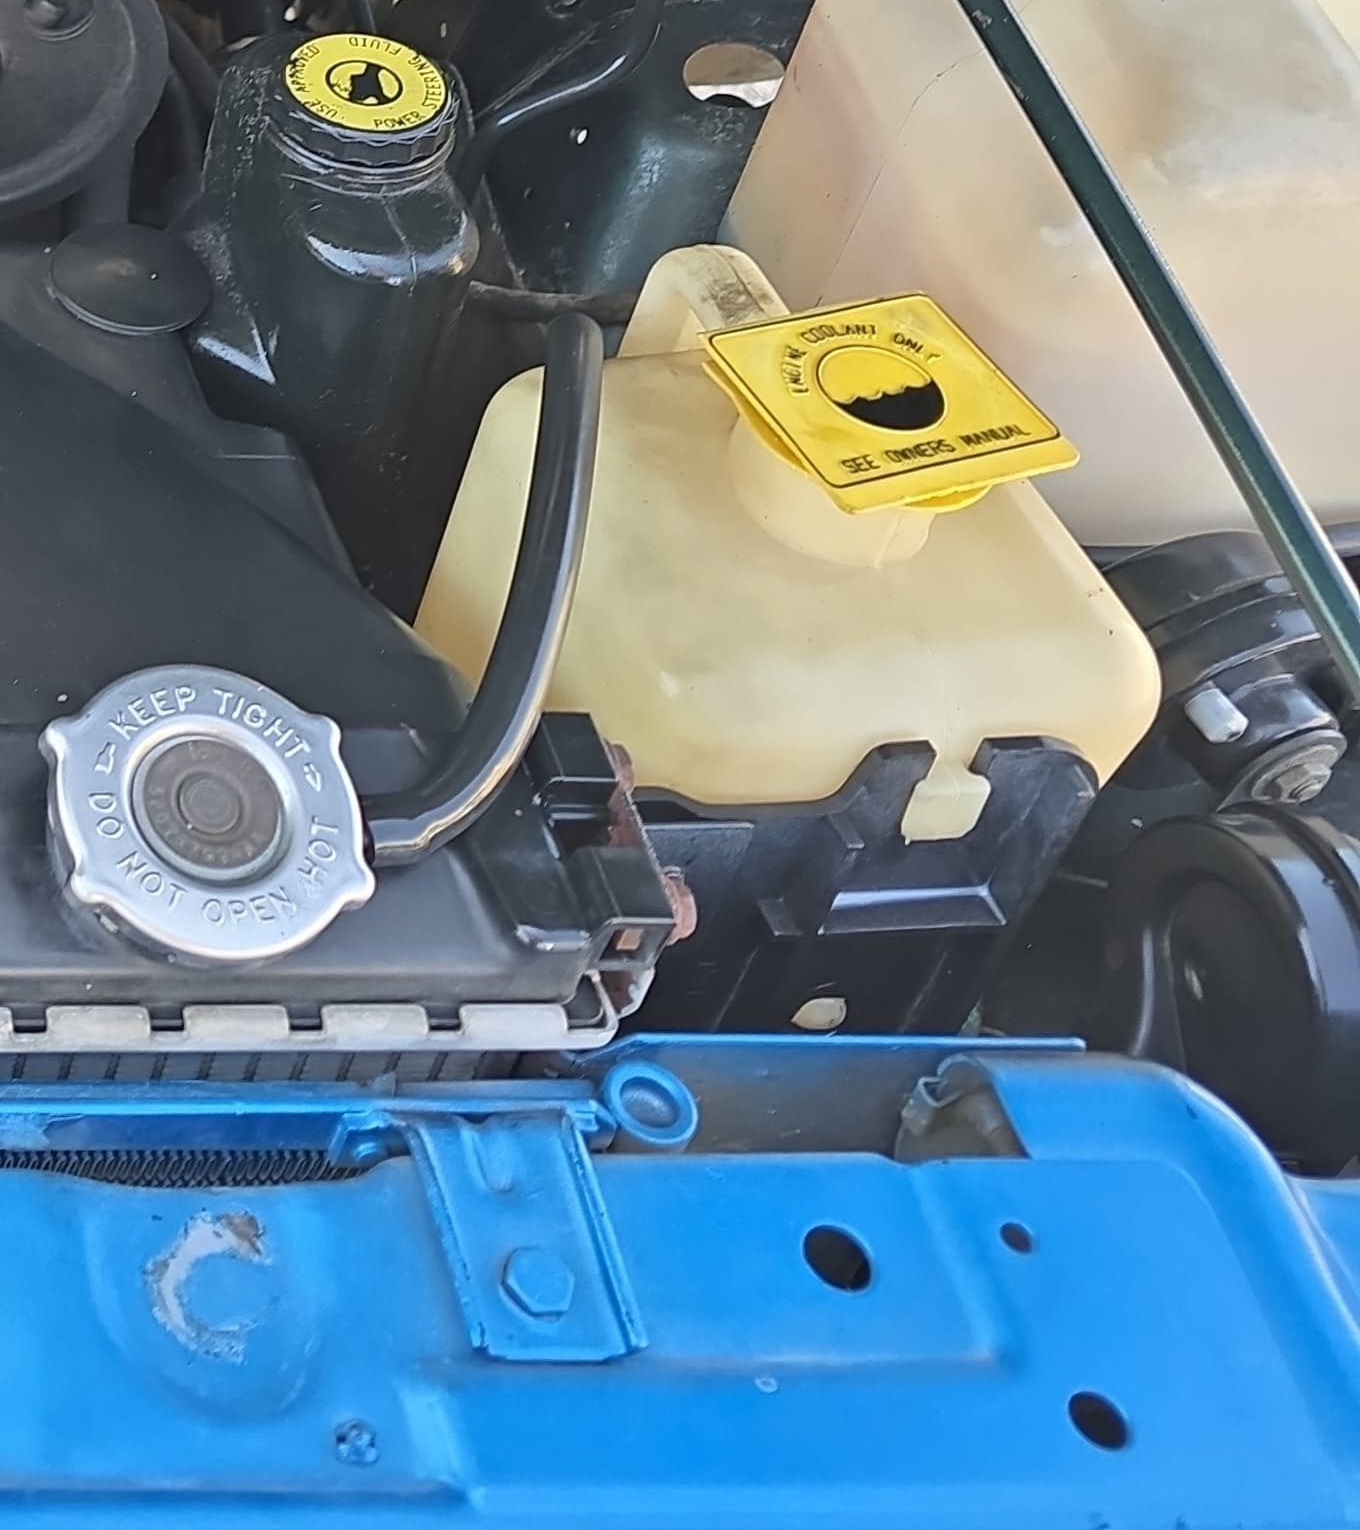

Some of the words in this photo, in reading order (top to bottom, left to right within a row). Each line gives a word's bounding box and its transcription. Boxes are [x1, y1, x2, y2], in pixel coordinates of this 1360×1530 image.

[349, 36, 402, 56] FLUID
[373, 110, 423, 129] POWER
[407, 54, 444, 111] STEERING
[780, 343, 810, 397] ENGINE
[799, 322, 878, 346] COOLANT
[891, 331, 944, 364] ONLY
[839, 453, 879, 476] SEE
[885, 438, 956, 465] OWNERS
[959, 423, 1032, 448] MANUAL
[108, 685, 198, 742] KEEP
[212, 688, 313, 760] TIGHT
[87, 793, 126, 840] DO
[116, 849, 188, 909] NOT
[200, 884, 299, 929] OPEN
[297, 814, 340, 886] HOT
